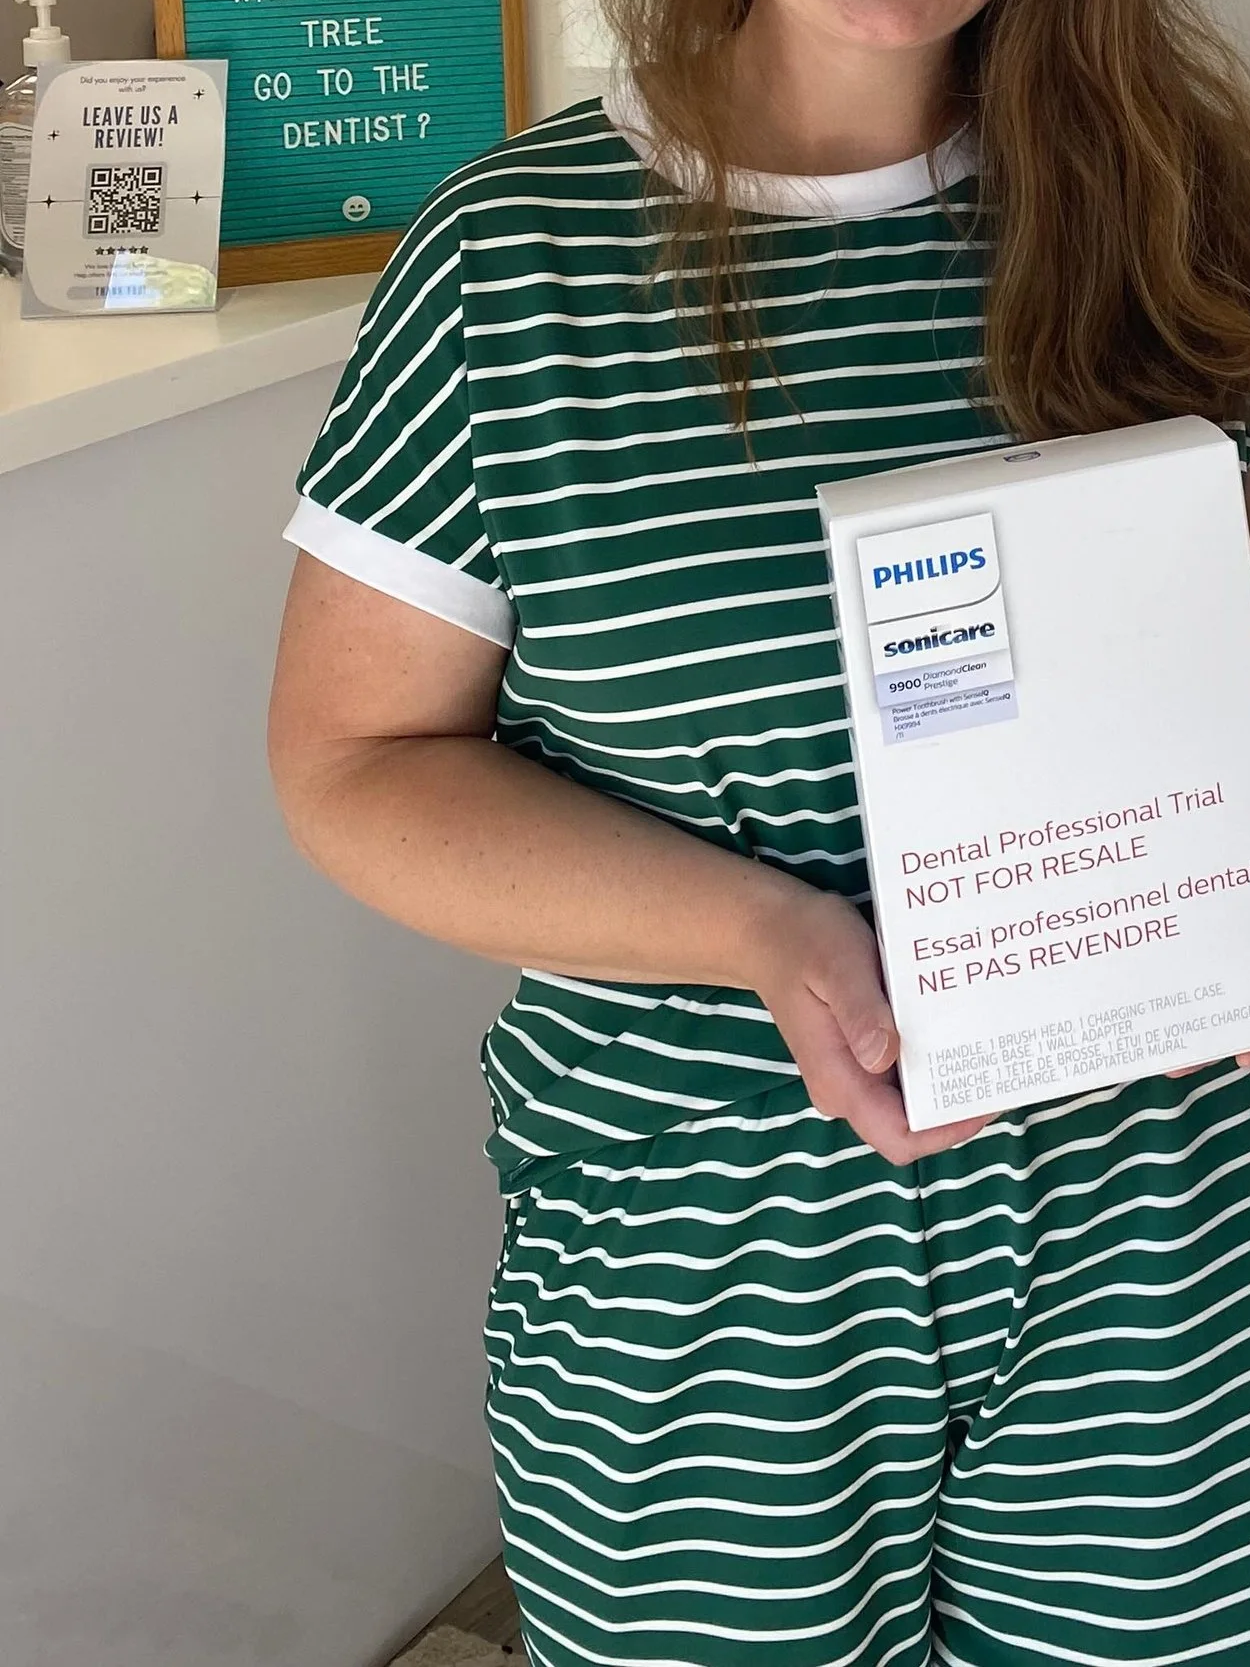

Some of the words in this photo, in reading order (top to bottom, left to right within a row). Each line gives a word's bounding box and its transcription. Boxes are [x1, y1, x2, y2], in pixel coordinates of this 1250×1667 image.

[300, 16, 384, 48] TREE
[80, 76, 93, 84] Did
[94, 78, 108, 86] you
[109, 77, 129, 86] enjoy
[131, 77, 146, 85] your
[148, 76, 186, 85] experience
[254, 71, 292, 101] GO
[316, 67, 353, 96] TO
[373, 62, 430, 95] THE
[83, 106, 134, 127] LEAVE
[140, 105, 161, 126] US
[168, 105, 178, 125] A
[94, 128, 164, 149] REVIEW!
[873, 547, 986, 589] PHILIPS
[883, 621, 995, 658] sonicare
[889, 678, 921, 693] 9900
[923, 662, 987, 681] DiamondClean
[924, 678, 958, 690] Prestige
[892, 706, 912, 714] Power
[914, 698, 948, 710] Toothbrush
[902, 835, 991, 875] Dental
[1000, 796, 1162, 854] Professional
[1168, 782, 1224, 814] Trial
[906, 876, 966, 909] NOT
[975, 862, 1033, 894] FOR
[1042, 835, 1148, 879] RESALE
[914, 927, 982, 961] Essai
[991, 882, 1170, 949] professionnel
[918, 967, 958, 995] NE
[966, 953, 1021, 984] PAS
[1030, 914, 1180, 970] REVENDRE
[998, 1028, 1037, 1049] BRUSH
[1087, 1002, 1147, 1027] CHARGING
[1149, 991, 1191, 1012] TRAVEL
[938, 1052, 998, 1077] CHARGING
[1046, 1034, 1078, 1052] WALL
[1082, 1020, 1134, 1044] ADAPTER
[1037, 1055, 1053, 1071] DE
[1145, 1029, 1160, 1044] DE
[1164, 1017, 1208, 1038] VOYAGE
[942, 1089, 972, 1109] BASE
[976, 1085, 992, 1100] DE
[1073, 1048, 1144, 1076] ADAPTATEUR
[1148, 1038, 1188, 1057] MURAL
